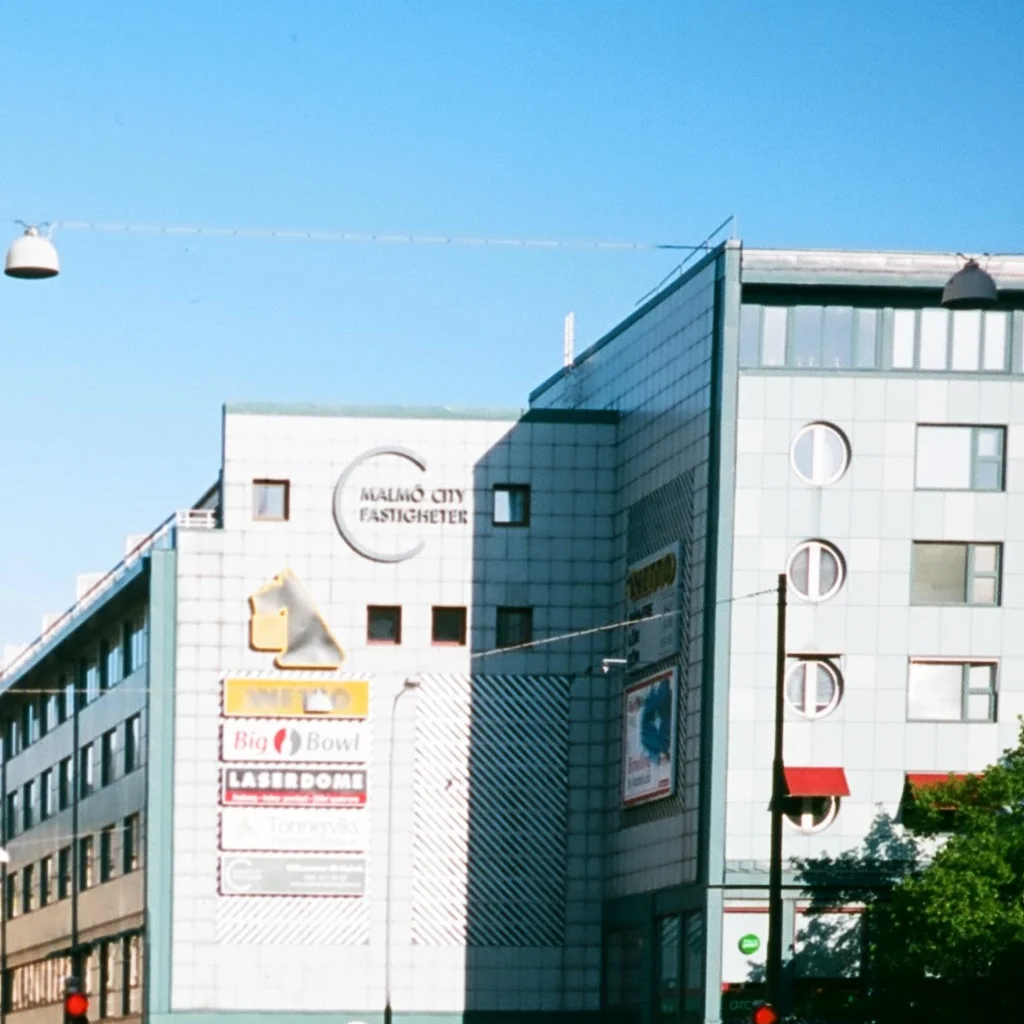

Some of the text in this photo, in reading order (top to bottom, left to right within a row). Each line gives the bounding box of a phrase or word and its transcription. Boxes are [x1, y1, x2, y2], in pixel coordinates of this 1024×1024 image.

[360, 484, 464, 504] MALMÖ CITY
[360, 508, 468, 524] FASTIGHETER
[233, 730, 360, 755] Big Bowl
[228, 771, 364, 790] LASERDOME
